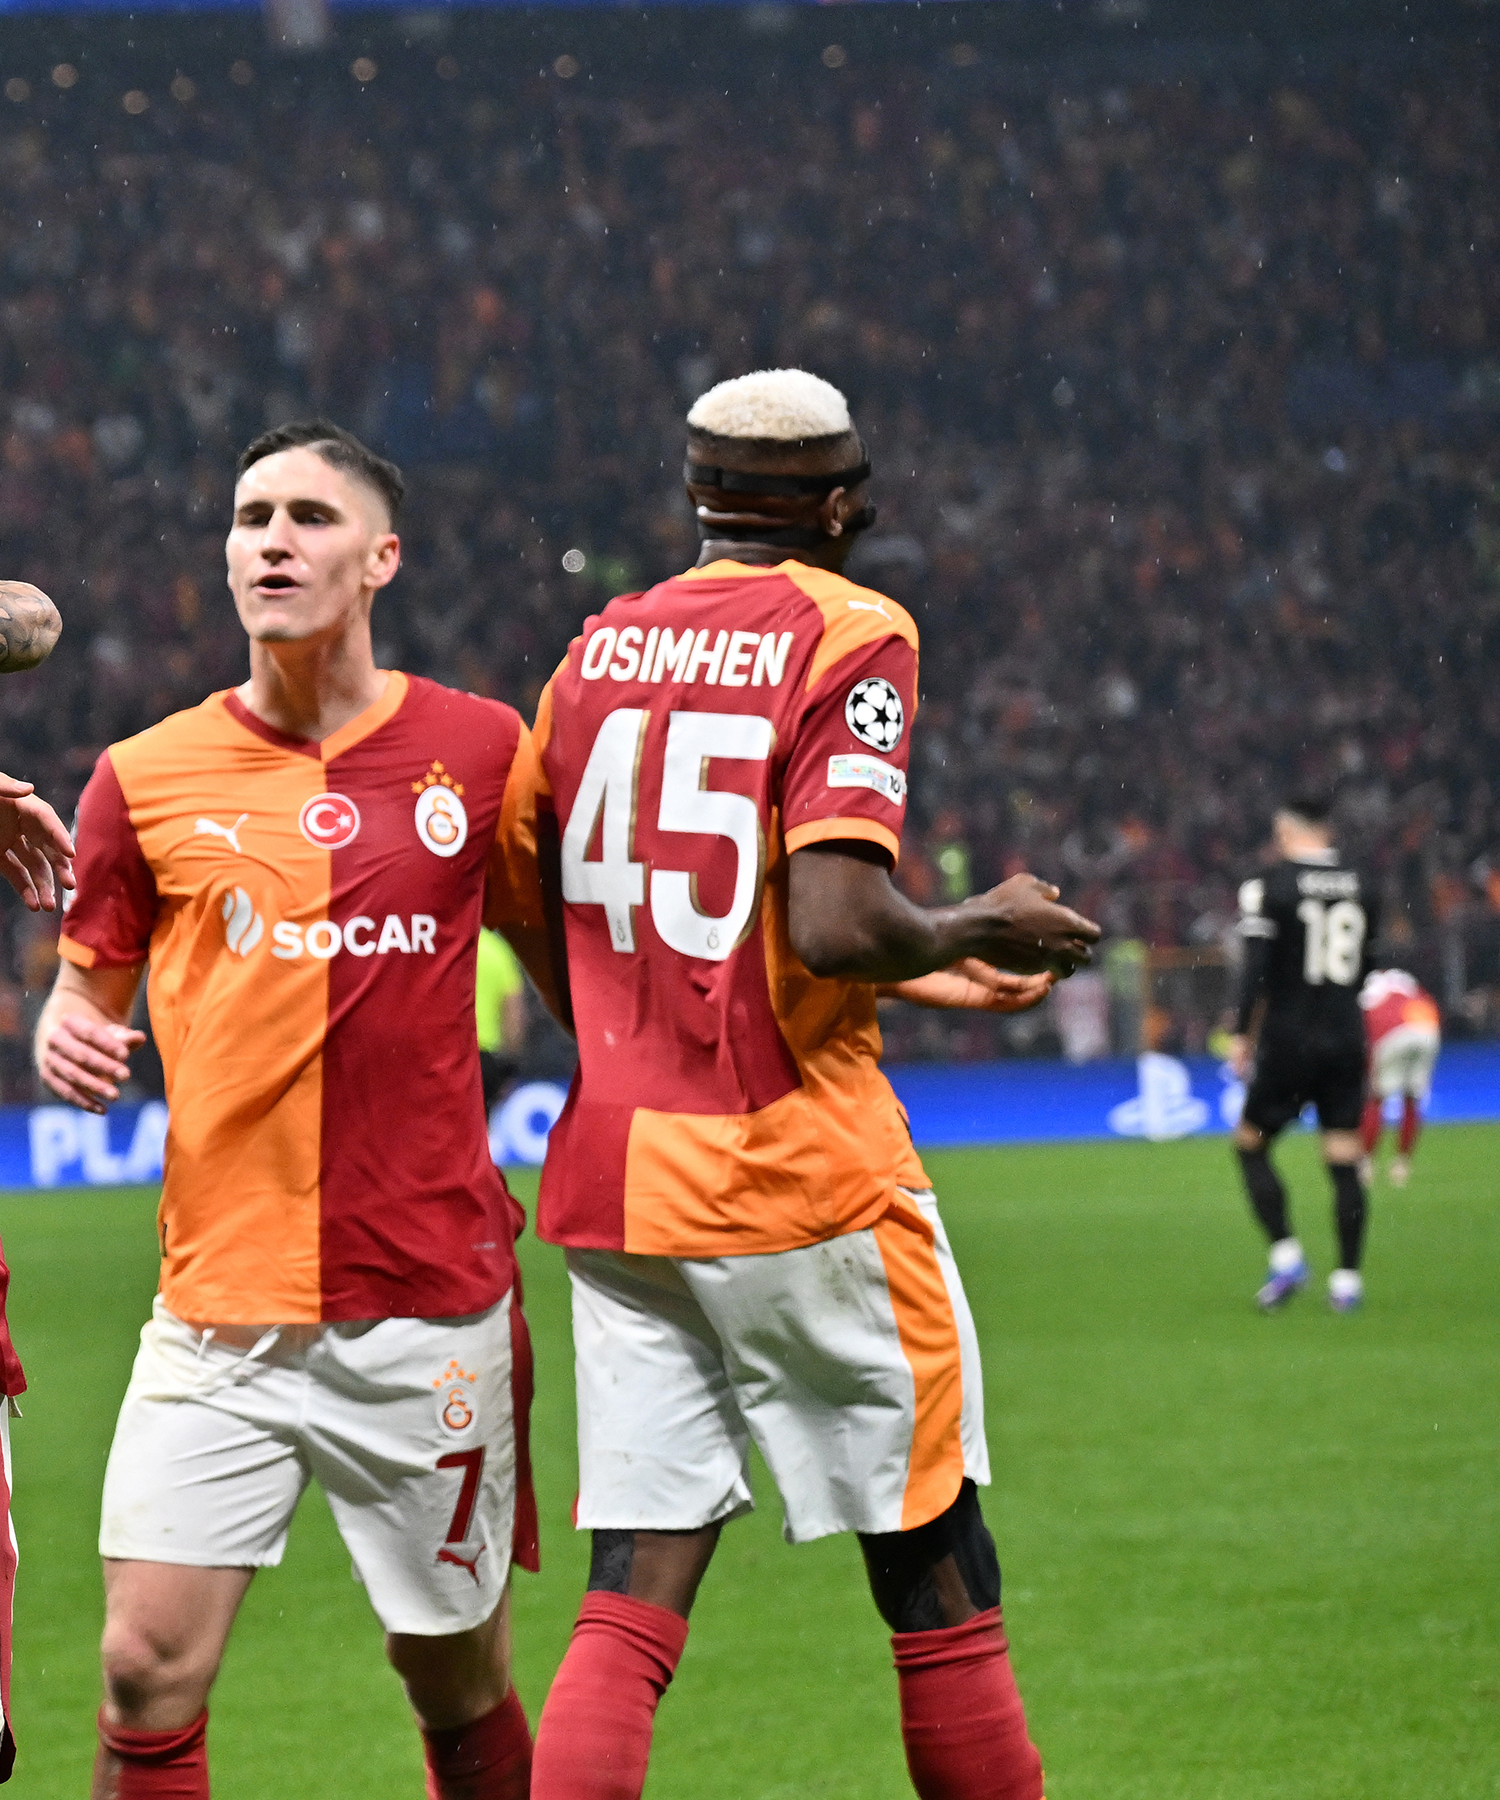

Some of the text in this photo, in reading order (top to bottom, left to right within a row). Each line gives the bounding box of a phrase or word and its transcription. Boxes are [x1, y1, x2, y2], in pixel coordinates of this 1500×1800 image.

[581, 626, 794, 687] OSIMHEN
[561, 708, 777, 961] 45
[271, 894, 438, 960] SOCAR
[1297, 899, 1367, 986] 18
[435, 1445, 486, 1544] 7
